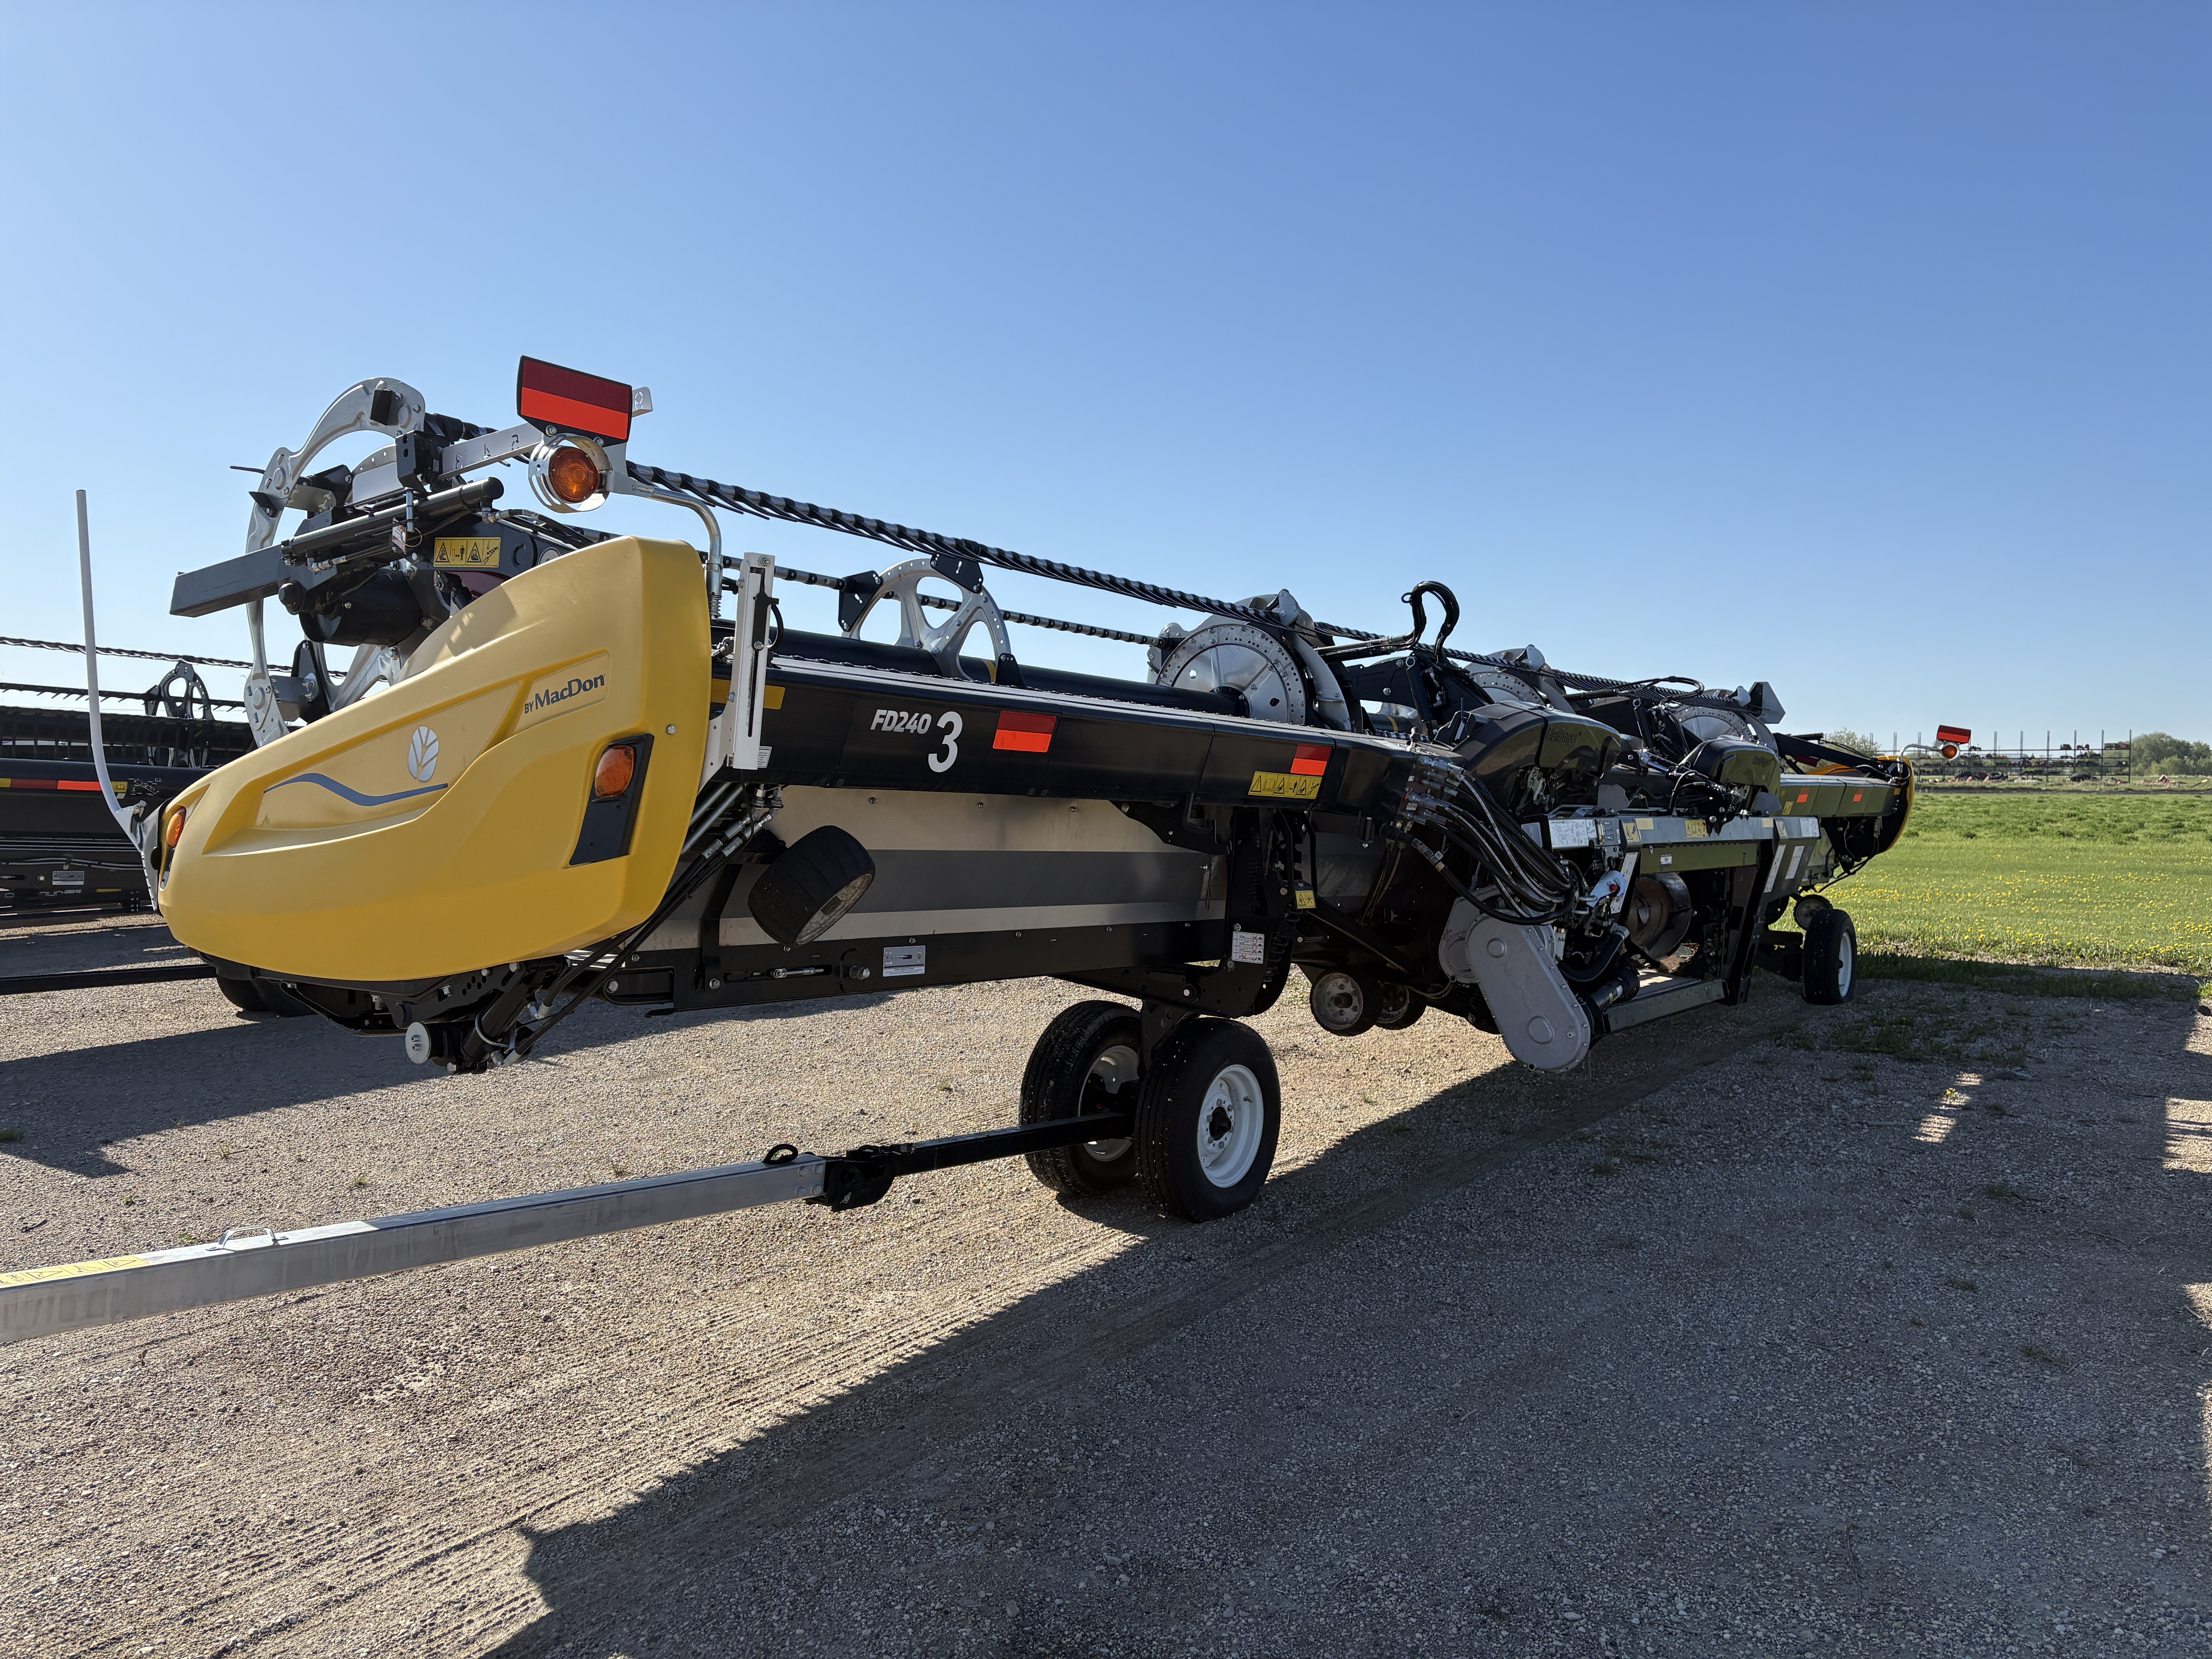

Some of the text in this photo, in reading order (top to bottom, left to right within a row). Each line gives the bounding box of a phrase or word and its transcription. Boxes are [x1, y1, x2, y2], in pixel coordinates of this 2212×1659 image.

[524, 674, 605, 714] BY MacDon
[870, 709, 963, 773] FD240 3
